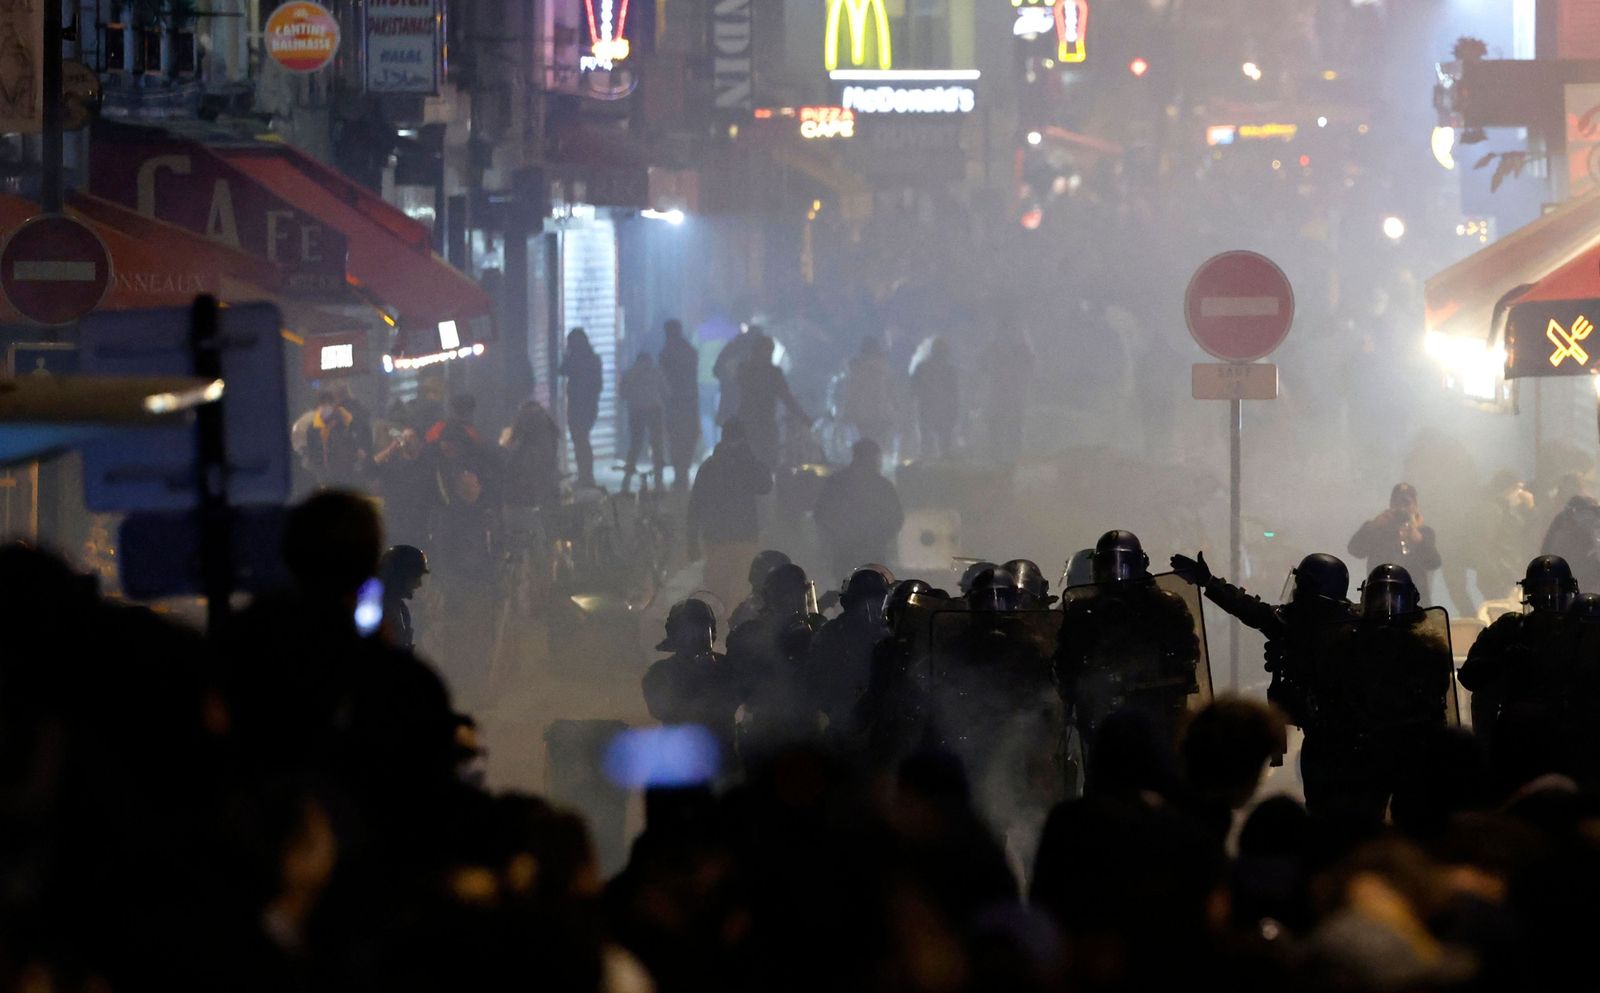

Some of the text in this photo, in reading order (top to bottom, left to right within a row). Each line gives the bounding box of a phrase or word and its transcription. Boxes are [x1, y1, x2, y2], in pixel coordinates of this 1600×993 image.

[274, 23, 327, 36] CANTINE
[381, 49, 421, 63] HALAL
[800, 106, 854, 122] PIZZA
